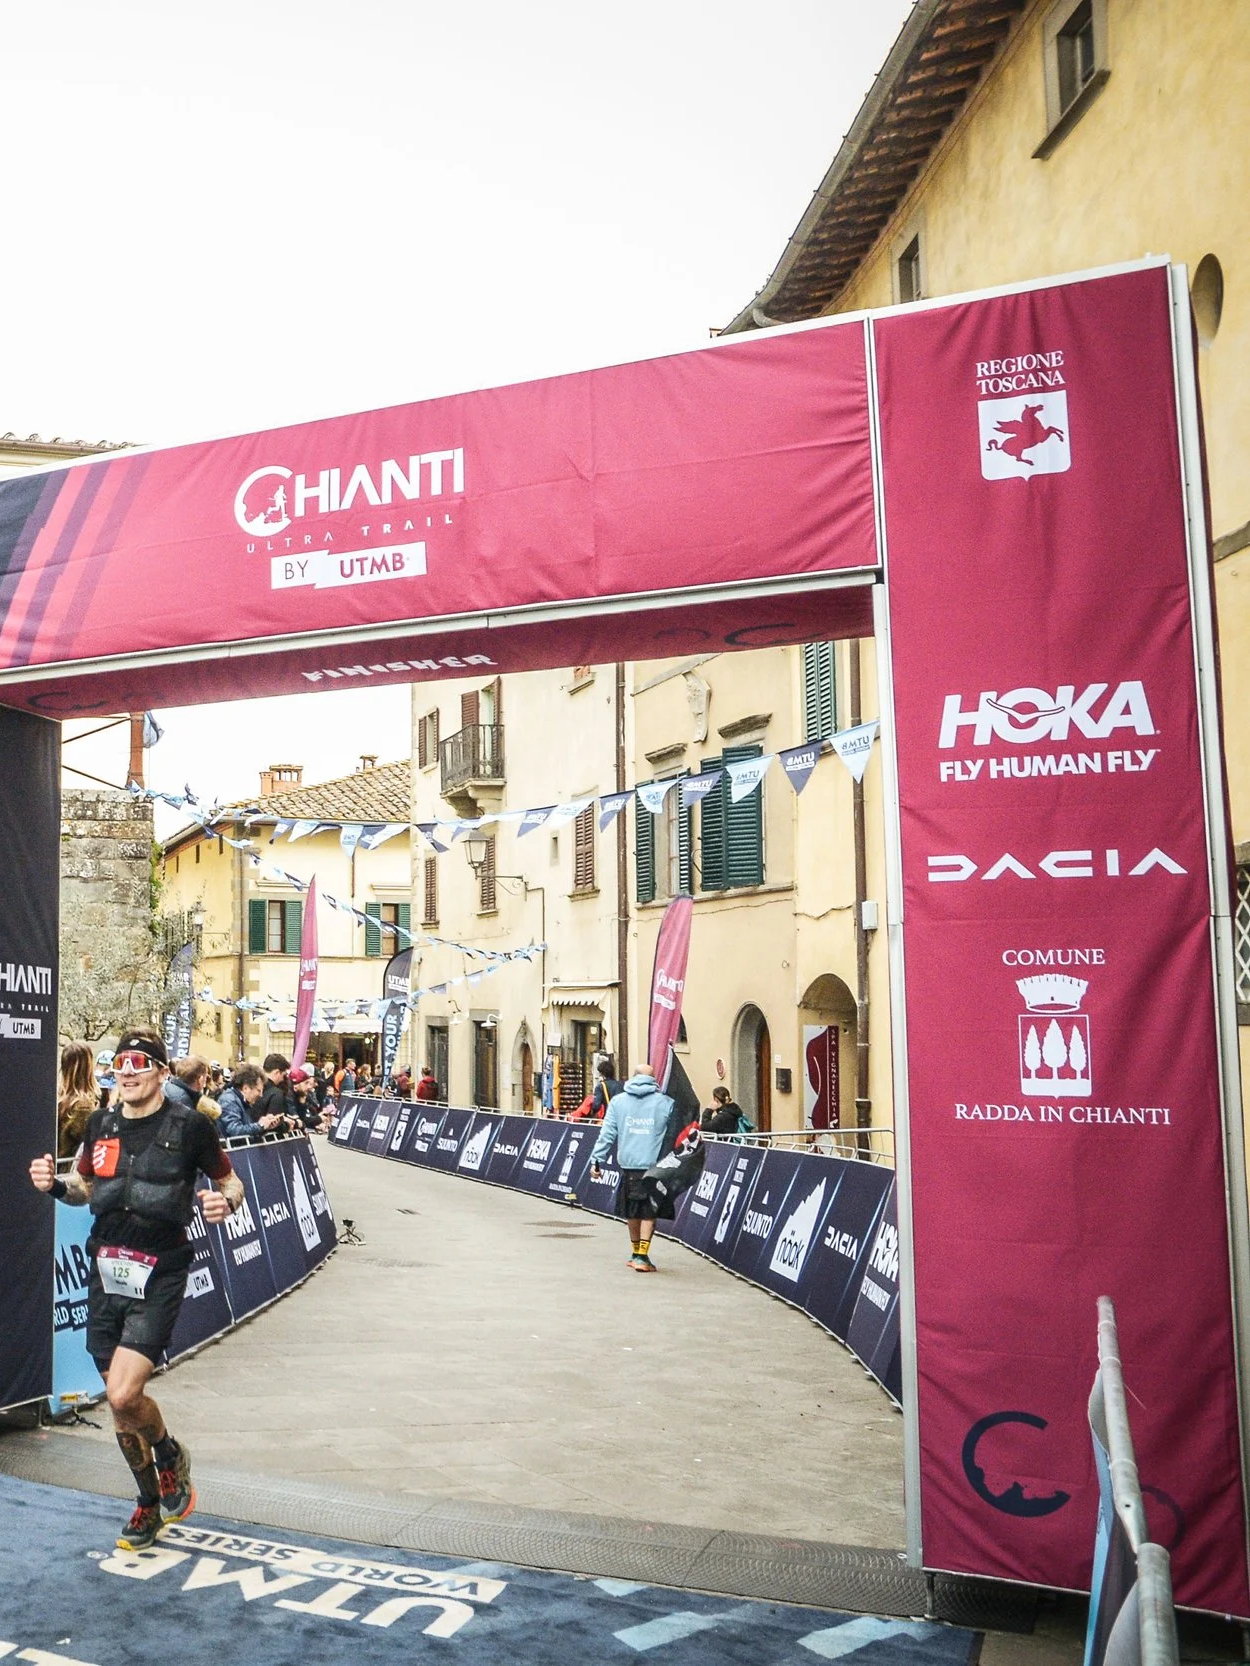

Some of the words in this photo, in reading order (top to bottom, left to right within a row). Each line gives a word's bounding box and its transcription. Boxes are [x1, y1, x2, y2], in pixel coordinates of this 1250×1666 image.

[976, 350, 1064, 378] REGIONE
[976, 370, 1066, 395] TOSCANA
[234, 447, 464, 537] CHIANTI
[246, 531, 334, 554] ULTRA
[361, 514, 453, 536] TRAIL
[284, 560, 308, 580] BY
[340, 552, 406, 578] UTMB
[301, 653, 498, 683] FINISHER
[938, 680, 1155, 748] HOKA
[940, 760, 984, 782] FLY
[989, 752, 1102, 779] HUMAN
[1107, 749, 1156, 773] FLY
[927, 847, 1188, 882] DACIA
[1002, 949, 1105, 966] COMUNE
[22, 1003, 50, 1013] TRAIL
[13, 1022, 35, 1034] UTMB
[384, 1014, 398, 1055] YOUR
[955, 1103, 1034, 1121] RADDA
[1040, 1105, 1064, 1122] IN
[1069, 1107, 1171, 1125] CHIANTI
[493, 1142, 518, 1157] DACIA
[261, 1202, 291, 1228] DACIA
[742, 1209, 773, 1240] SUUNTO
[824, 1226, 858, 1261] DACIA
[54, 1244, 90, 1295] MB
[113, 1267, 130, 1279] 125
[53, 1306, 70, 1326] RLD
[165, 1528, 299, 1560] SERIES
[99, 1547, 475, 1639] UTMB
[311, 1561, 479, 1596] WORLD
